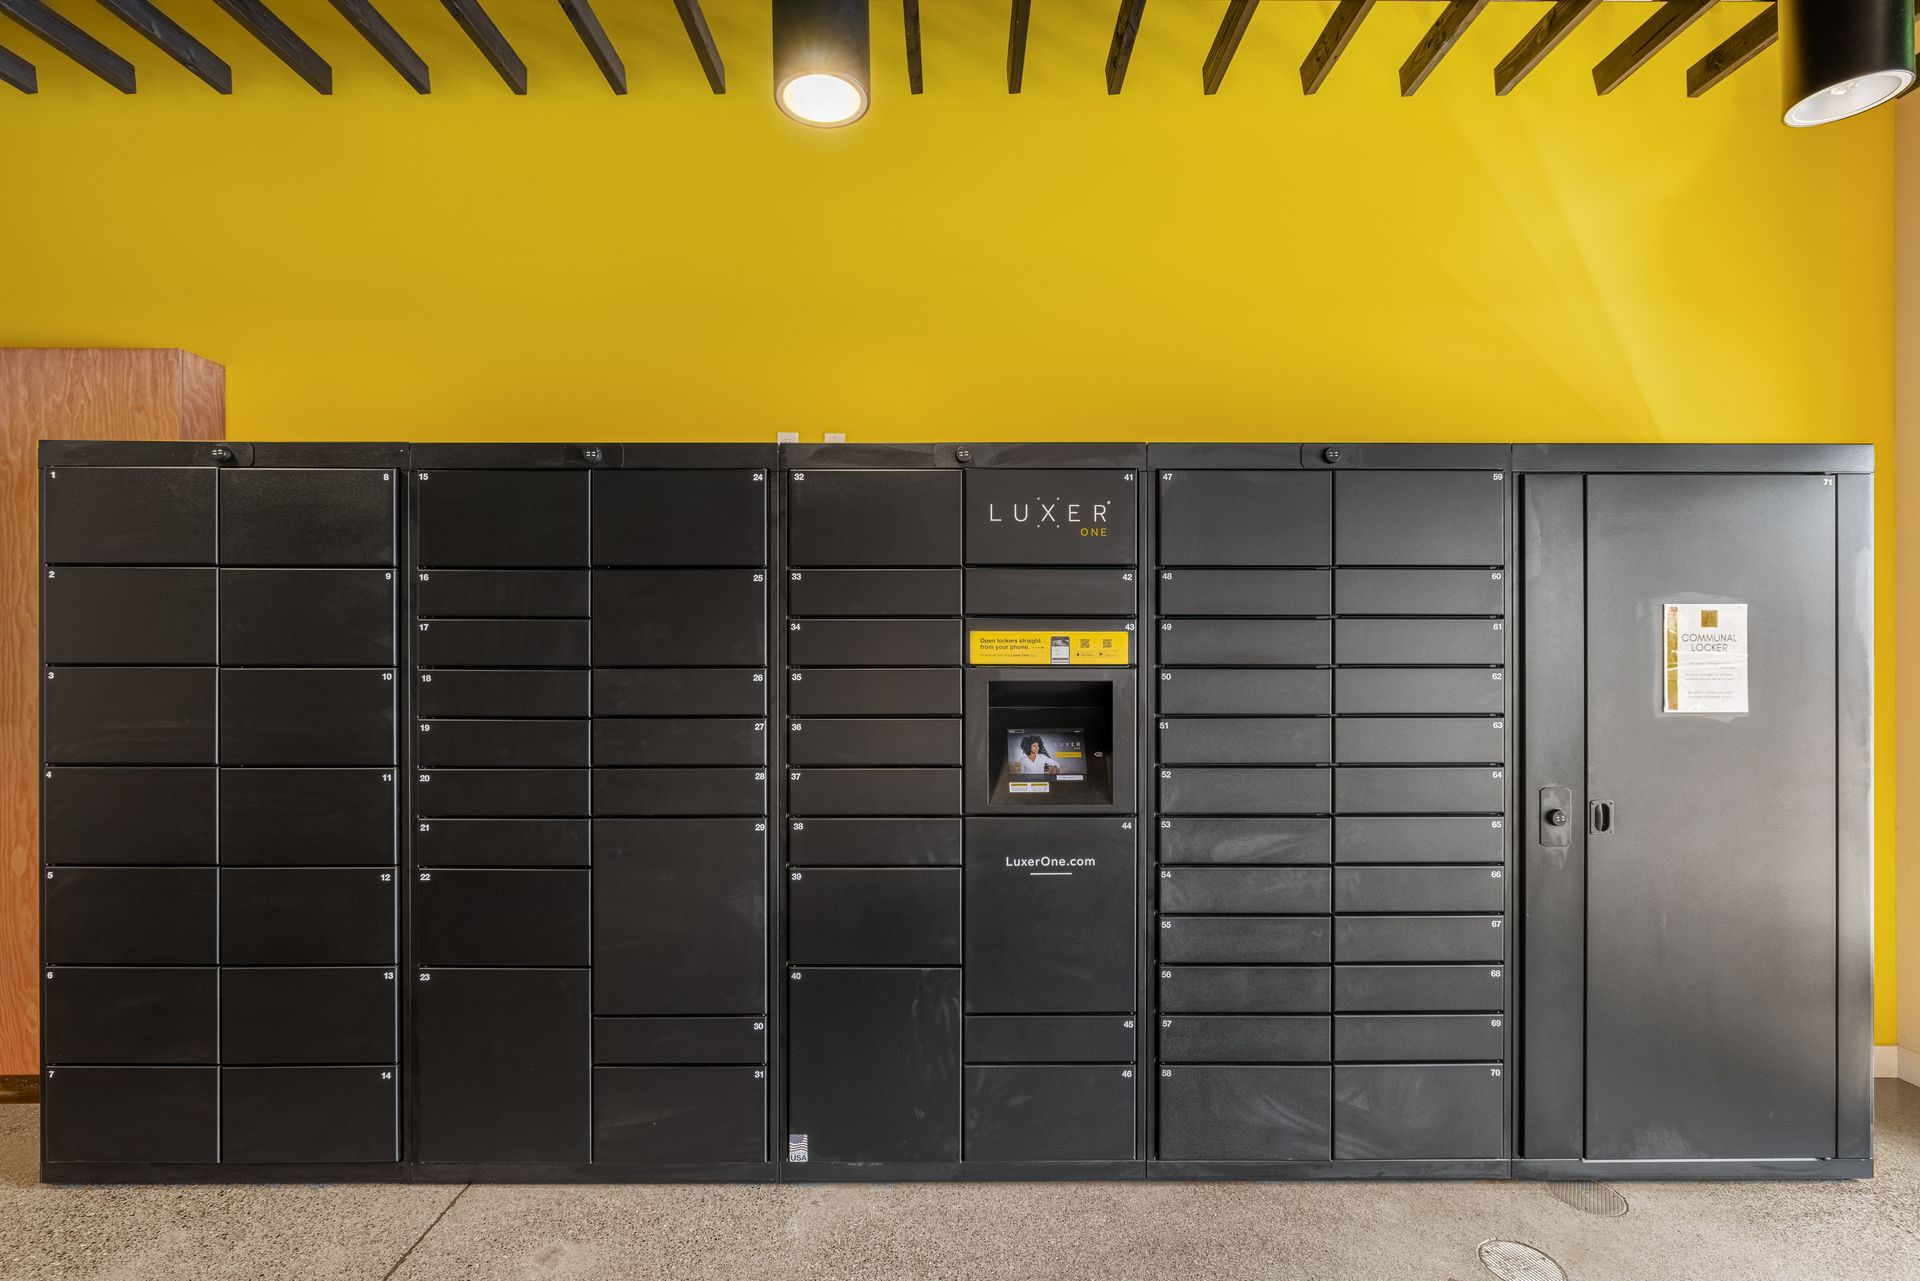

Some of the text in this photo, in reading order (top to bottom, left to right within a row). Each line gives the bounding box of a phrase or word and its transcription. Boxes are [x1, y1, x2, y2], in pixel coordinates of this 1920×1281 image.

[50, 471, 56, 479] 1
[383, 473, 390, 481] 8
[418, 472, 429, 481] 15
[752, 473, 764, 482] 24
[793, 472, 805, 481] 32
[1123, 473, 1134, 481] 41
[1162, 473, 1173, 481] 47
[1492, 473, 1503, 481] 59
[1823, 478, 1833, 486] 71
[990, 503, 1107, 523] LUXER
[1080, 527, 1107, 537] ONE
[48, 570, 56, 579] 2
[385, 572, 392, 580] 9
[418, 573, 430, 581] 16
[752, 574, 764, 582] 25
[791, 572, 802, 581] 33
[1122, 573, 1133, 581] 42
[1162, 572, 1173, 580] 48
[1491, 572, 1502, 580] 60
[418, 623, 430, 632] 17
[790, 623, 801, 631] 34
[1124, 623, 1135, 631] 43
[1161, 623, 1172, 631] 49
[1492, 623, 1503, 631] 61
[1681, 633, 1737, 643] COMMUNAL
[1691, 643, 1729, 652] LOCKER
[47, 671, 55, 680] 3
[381, 672, 393, 681] 10
[421, 674, 432, 683] 18
[752, 673, 764, 682] 26
[791, 673, 802, 681] 35
[1161, 672, 1172, 681] 50
[1492, 672, 1502, 680] 62
[419, 724, 431, 732] 19
[754, 722, 765, 731] 27
[791, 723, 802, 731] 36
[1159, 722, 1170, 730] 51
[1492, 721, 1503, 729] 63
[45, 770, 53, 779] 4
[381, 773, 392, 782] 11
[419, 774, 431, 782] 20
[754, 772, 765, 781] 28
[790, 772, 802, 781] 37
[1161, 770, 1172, 779] 52
[1492, 771, 1503, 779] 64
[419, 823, 430, 832] 21
[754, 823, 765, 832] 29
[793, 822, 804, 831] 38
[1121, 822, 1132, 830] 44
[1161, 820, 1171, 829] 53
[1491, 820, 1502, 828] 65
[1005, 856, 1096, 867] LuxerOne.com
[47, 871, 54, 879] 5
[380, 873, 391, 882] 12
[419, 873, 431, 881] 22
[791, 872, 802, 881] 39
[1160, 870, 1172, 879] 54
[1491, 870, 1502, 878] 66
[1161, 920, 1172, 929] 55
[1491, 920, 1502, 928] 67
[46, 971, 54, 980] 6
[383, 971, 394, 980] 13
[419, 973, 431, 982] 23
[790, 972, 802, 980] 40
[1161, 970, 1172, 979] 56
[1490, 969, 1501, 978] 68
[753, 1022, 764, 1031] 30
[1123, 1020, 1134, 1029] 45
[1162, 1019, 1173, 1028] 57
[1491, 1019, 1502, 1027] 69
[48, 1070, 55, 1079] 7
[380, 1071, 392, 1080] 14
[754, 1070, 764, 1079] 31
[1121, 1069, 1132, 1078] 46
[1161, 1069, 1172, 1077] 58
[1490, 1068, 1501, 1077] 70
[790, 1154, 807, 1162] USA
